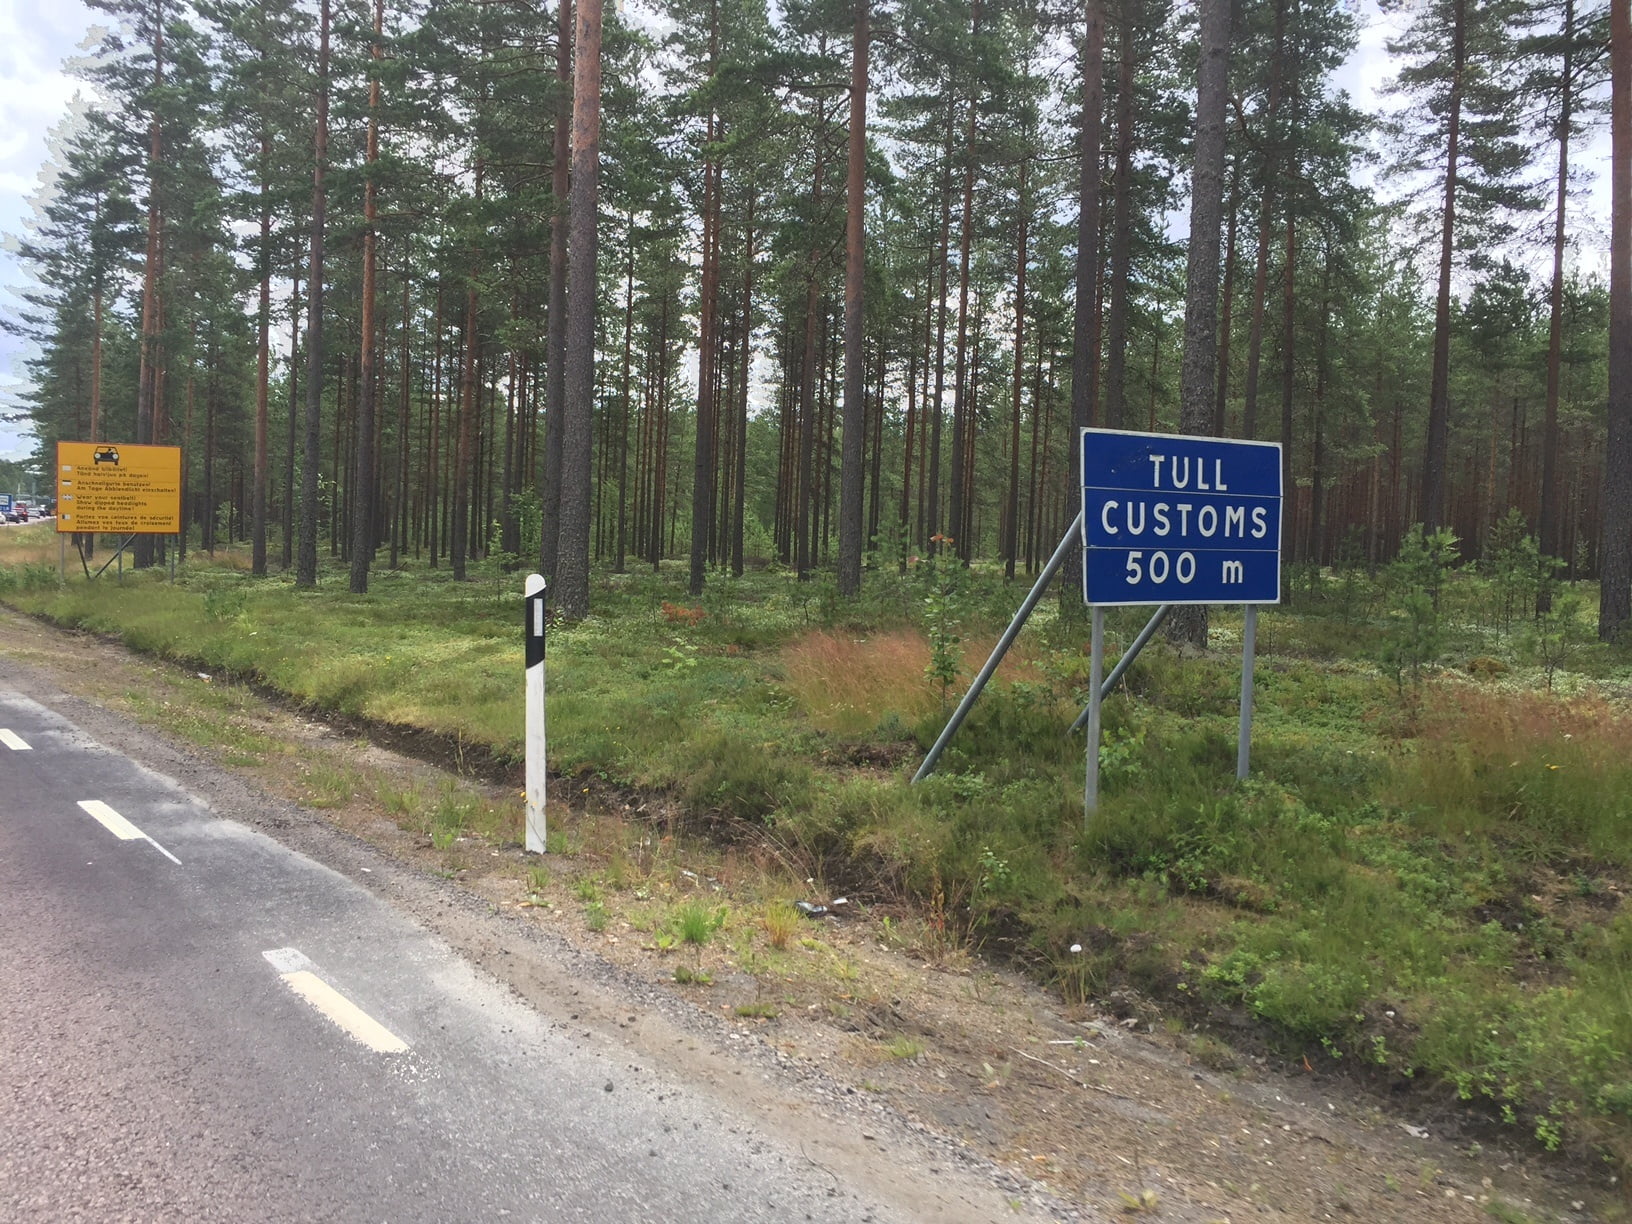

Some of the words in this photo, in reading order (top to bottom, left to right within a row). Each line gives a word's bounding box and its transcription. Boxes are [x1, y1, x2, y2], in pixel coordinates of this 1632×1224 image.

[1149, 454, 1227, 491] TULL
[1101, 500, 1267, 539] CUSTOMS
[1125, 551, 1196, 585] 500
[1222, 560, 1243, 583] m
